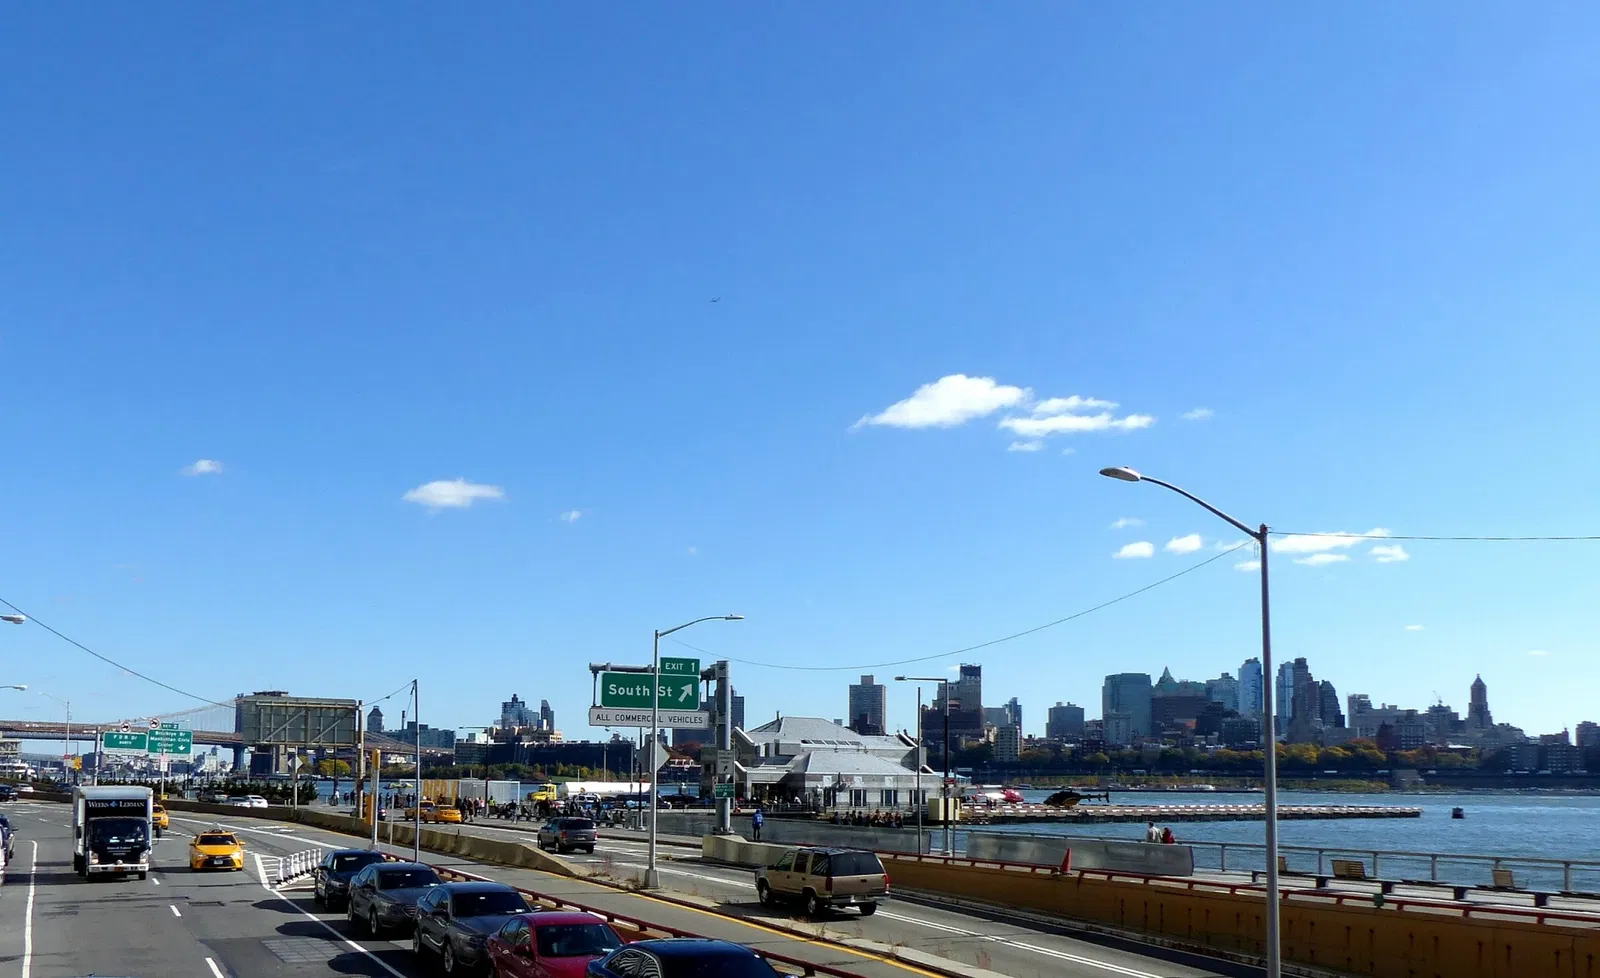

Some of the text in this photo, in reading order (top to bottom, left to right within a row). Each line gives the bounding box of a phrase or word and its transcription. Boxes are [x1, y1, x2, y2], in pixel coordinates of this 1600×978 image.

[665, 662, 695, 673] EXIT 1
[608, 684, 673, 697] South St
[596, 713, 703, 724] ALL COMMERCL VEHICLES
